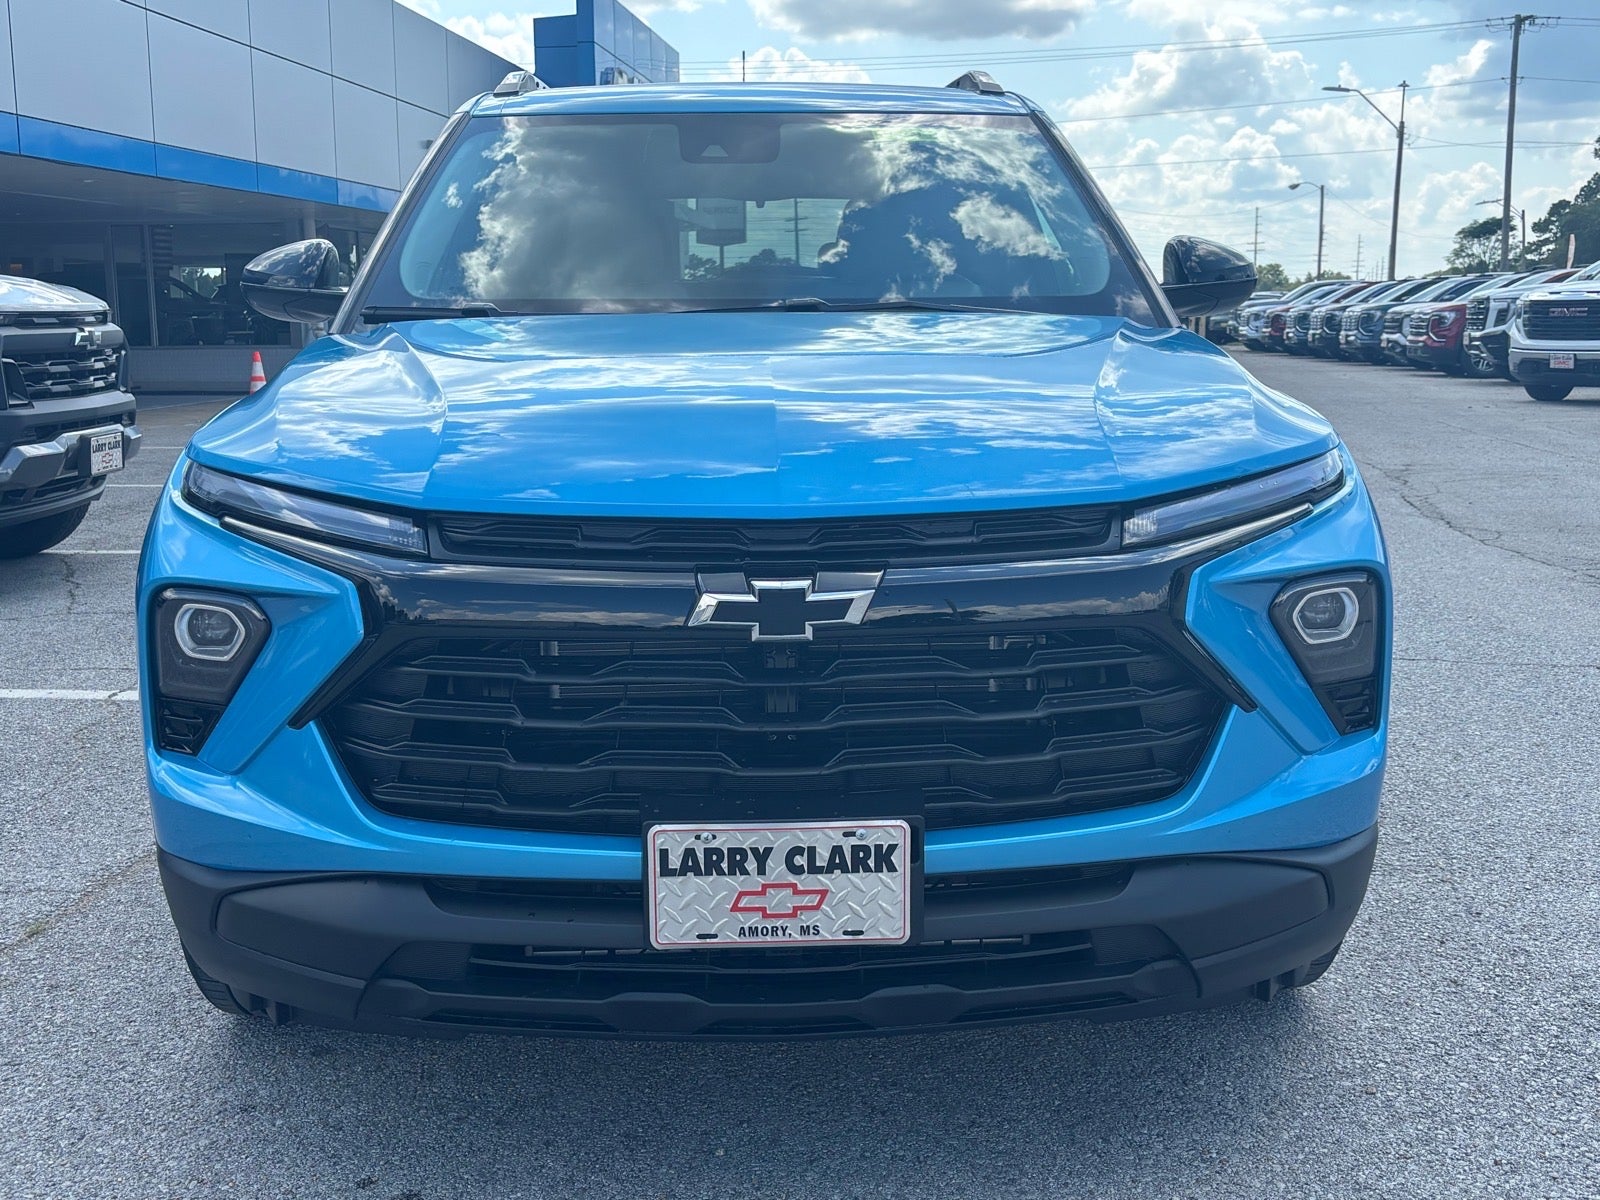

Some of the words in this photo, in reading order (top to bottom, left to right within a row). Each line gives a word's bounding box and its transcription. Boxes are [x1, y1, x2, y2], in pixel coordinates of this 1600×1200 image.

[659, 846, 774, 877] LARRY
[784, 843, 899, 875] CLARK
[738, 925, 792, 938] AMORY,
[800, 924, 821, 936] MS
